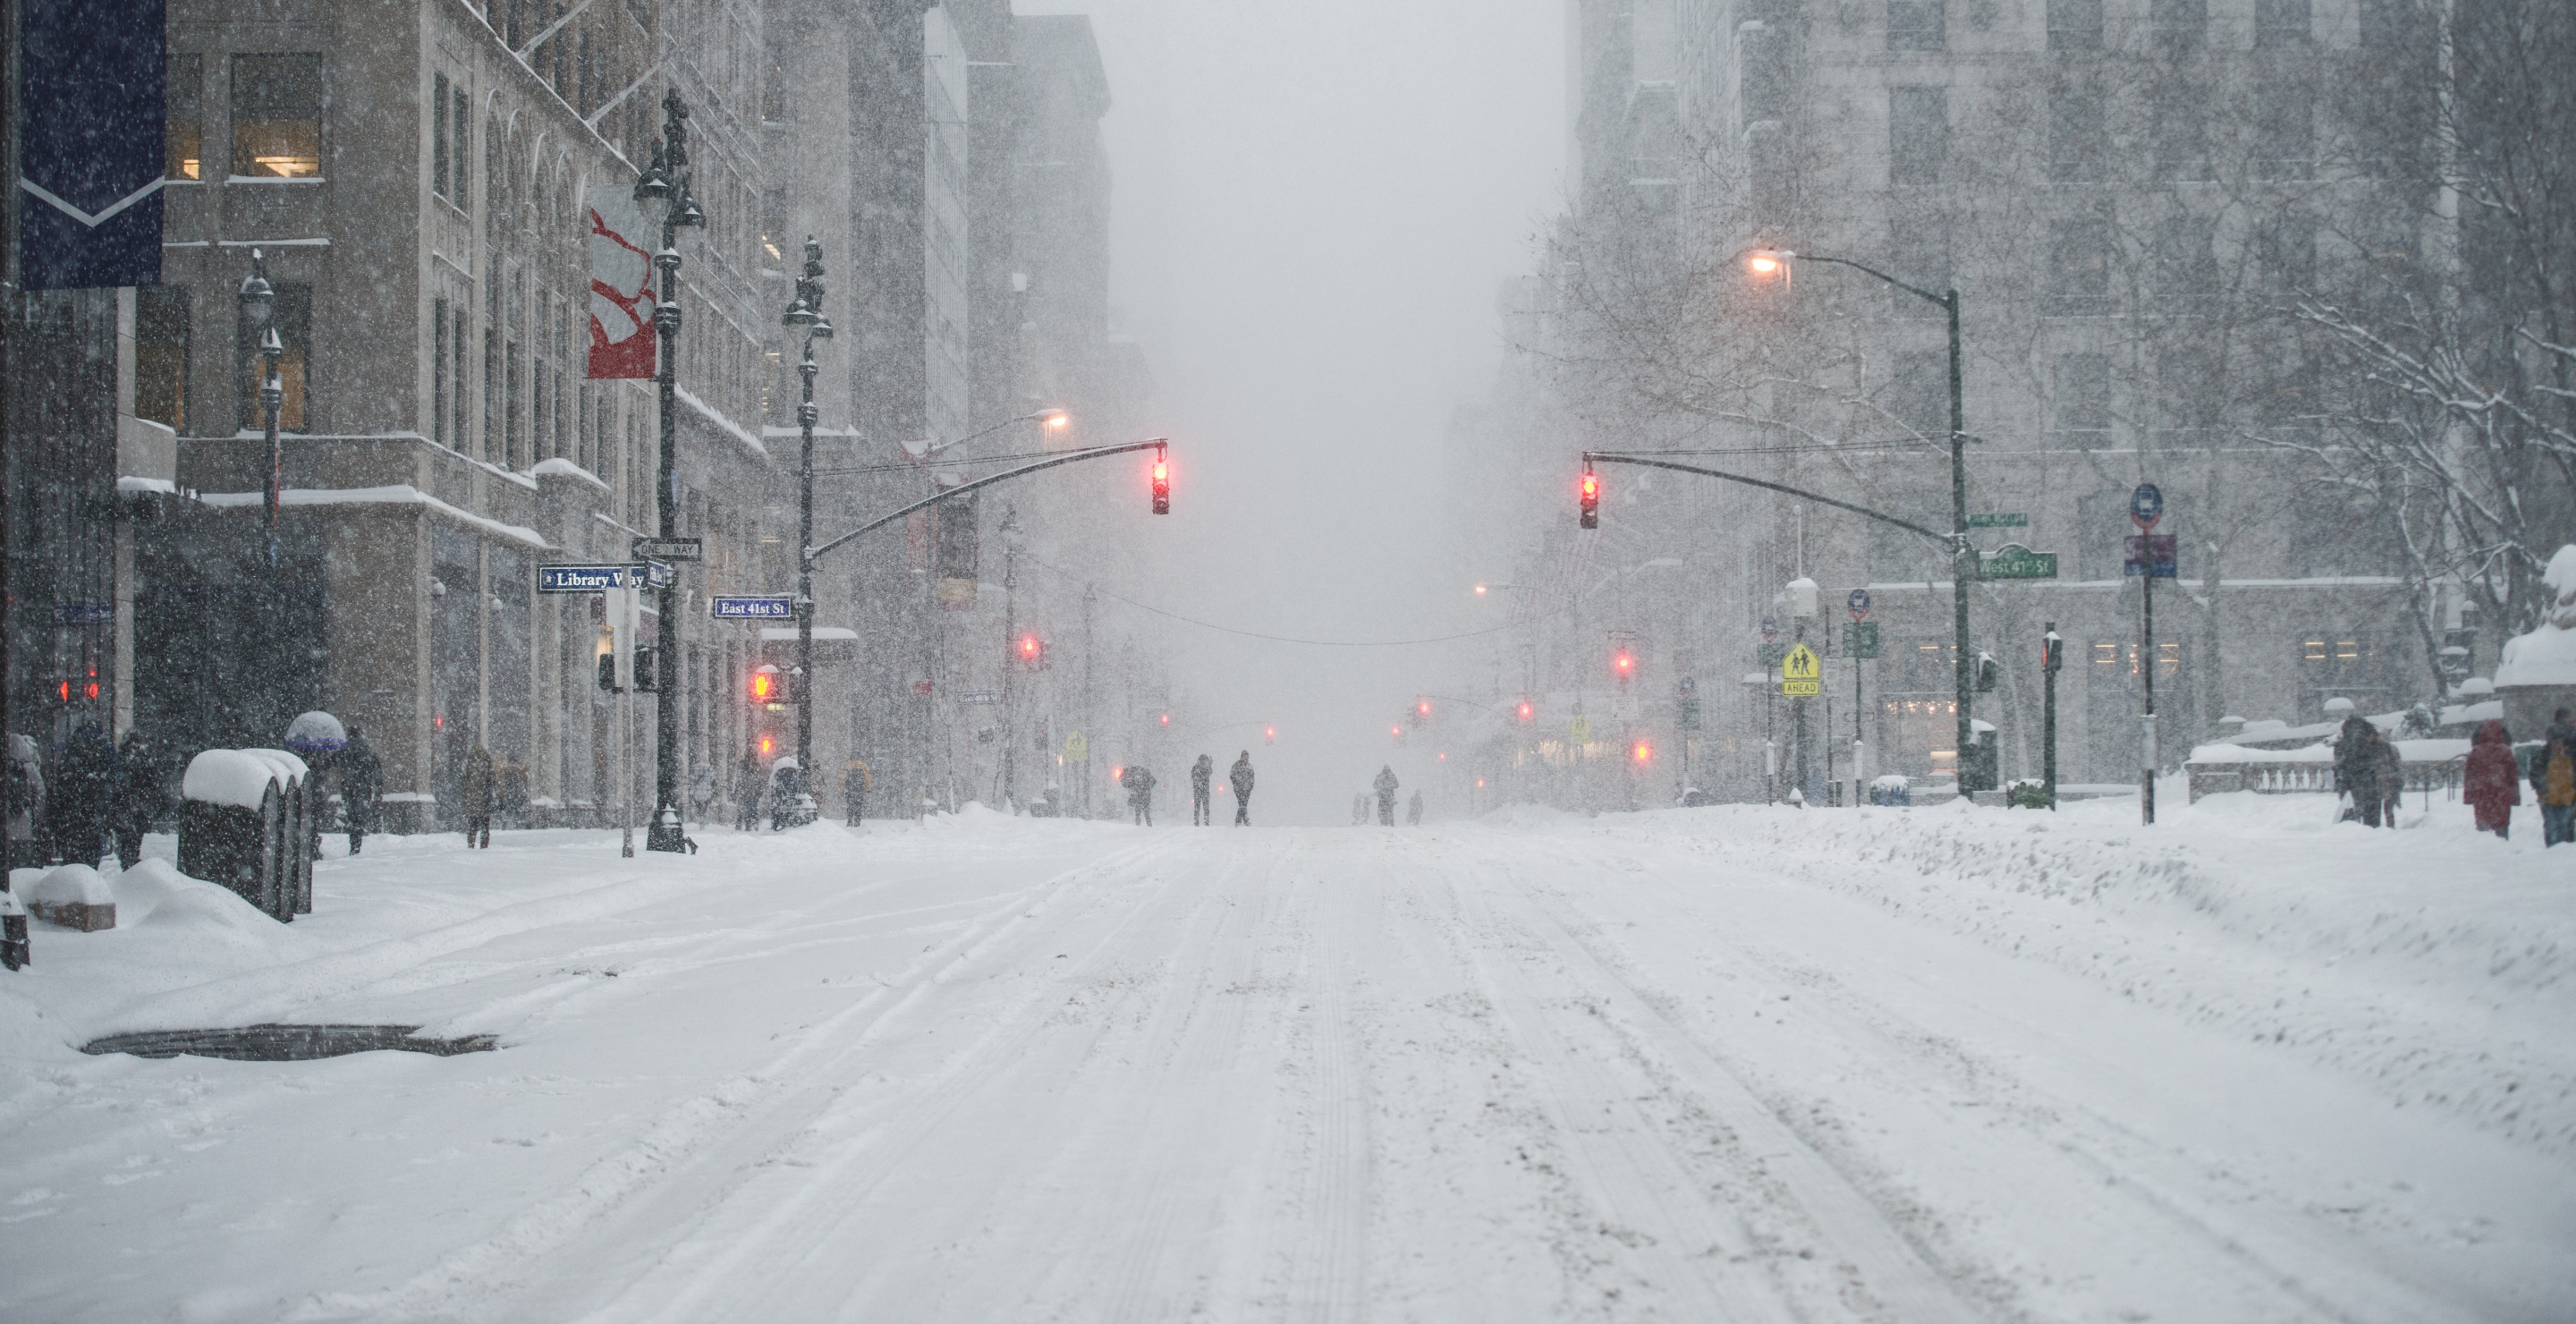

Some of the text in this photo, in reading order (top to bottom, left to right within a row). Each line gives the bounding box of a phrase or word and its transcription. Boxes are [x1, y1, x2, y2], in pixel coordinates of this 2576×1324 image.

[641, 545, 694, 554] ONE WAY
[1979, 559, 2009, 573] West
[2036, 560, 2049, 573] St
[556, 573, 608, 589] Library
[721, 602, 784, 614] East 41st St
[1787, 683, 1816, 692] AHEAD
